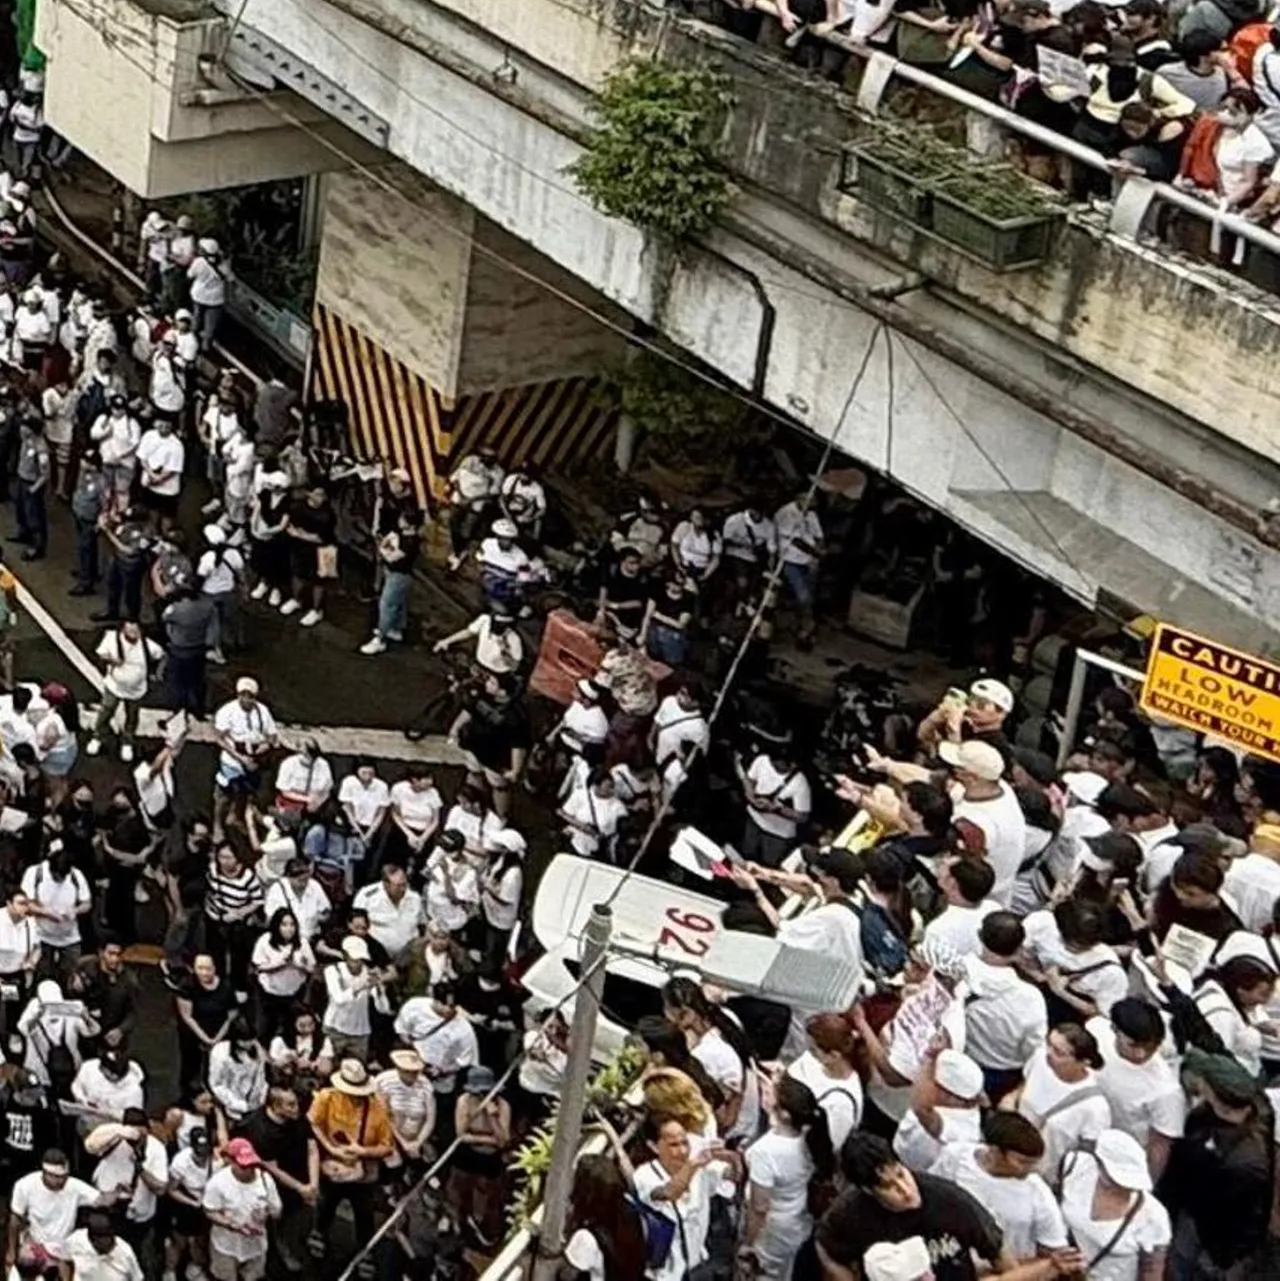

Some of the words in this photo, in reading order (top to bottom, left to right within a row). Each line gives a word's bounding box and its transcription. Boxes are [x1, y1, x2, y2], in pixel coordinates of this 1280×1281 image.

[1171, 637, 1280, 690] CAUTI
[1180, 667, 1257, 708] LOW
[1154, 694, 1213, 727] WATCH
[1219, 719, 1267, 747] YOUR
[1157, 676, 1274, 733] HEADROOM
